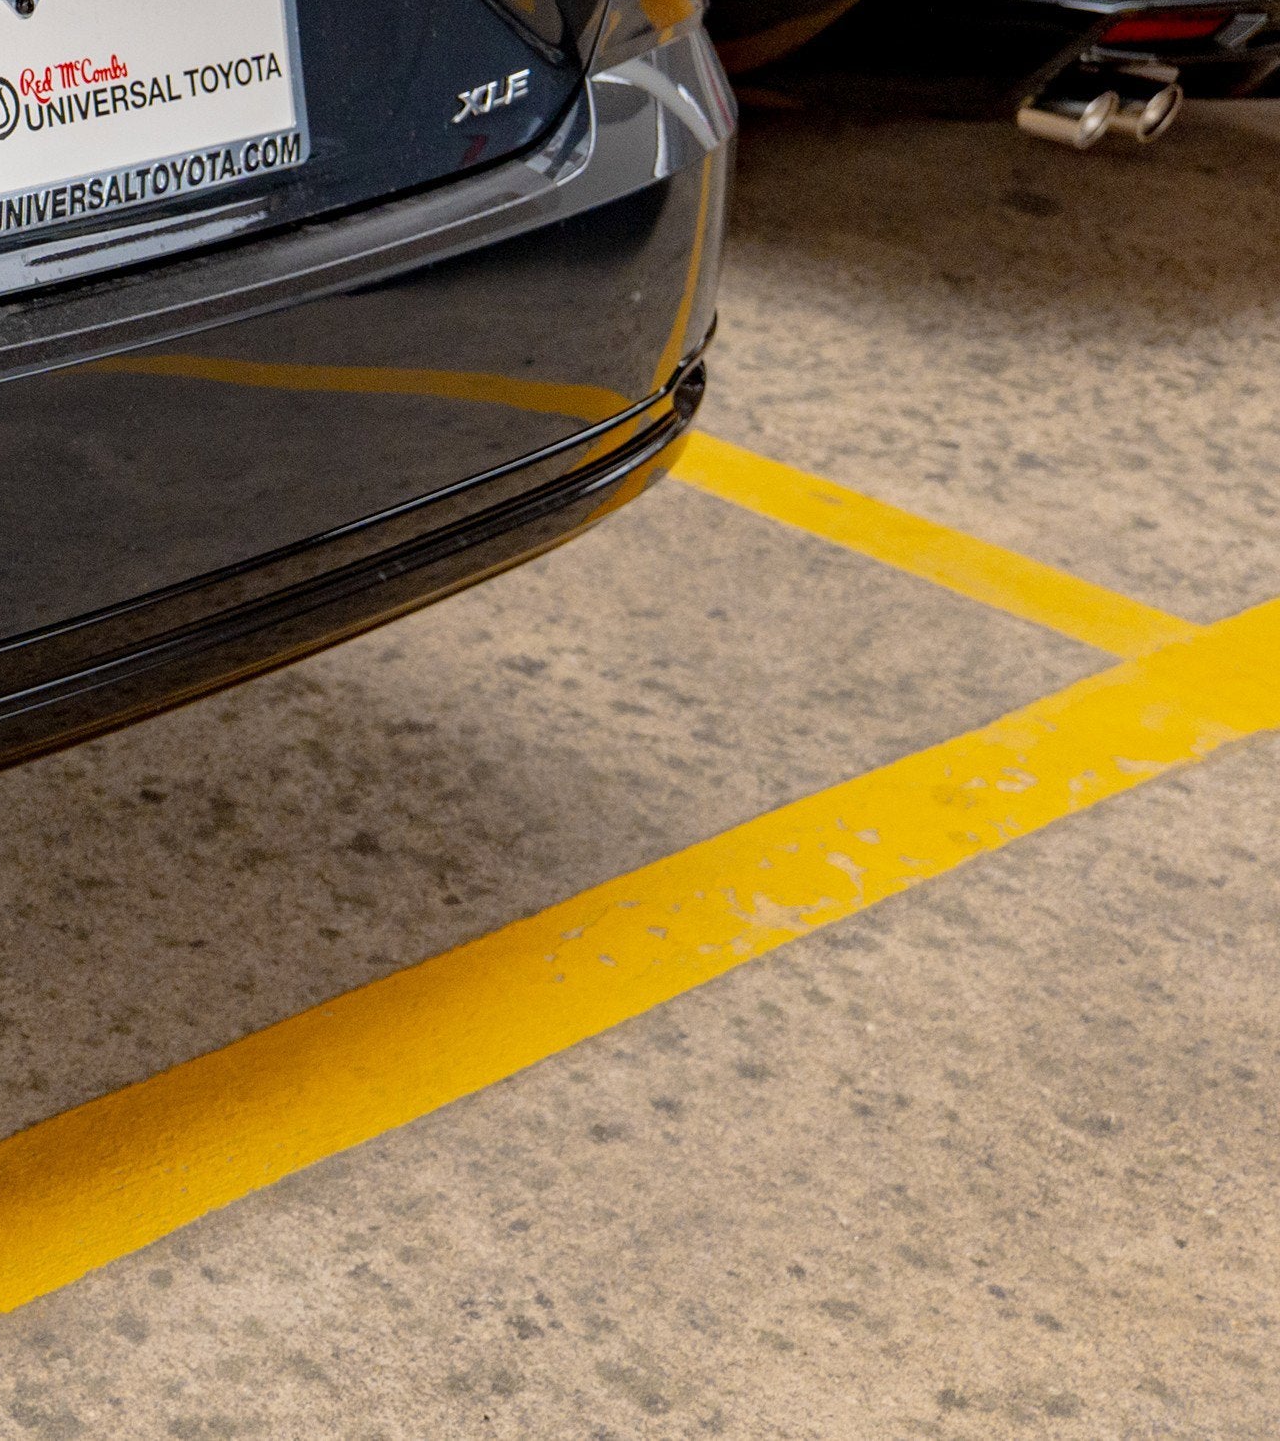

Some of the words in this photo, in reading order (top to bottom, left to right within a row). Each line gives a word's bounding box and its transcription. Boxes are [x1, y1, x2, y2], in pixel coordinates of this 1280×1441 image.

[19, 66, 54, 103] Red
[24, 77, 182, 131] UNIVERSAL
[184, 52, 282, 100] TOYOTA
[451, 68, 531, 124] XLE
